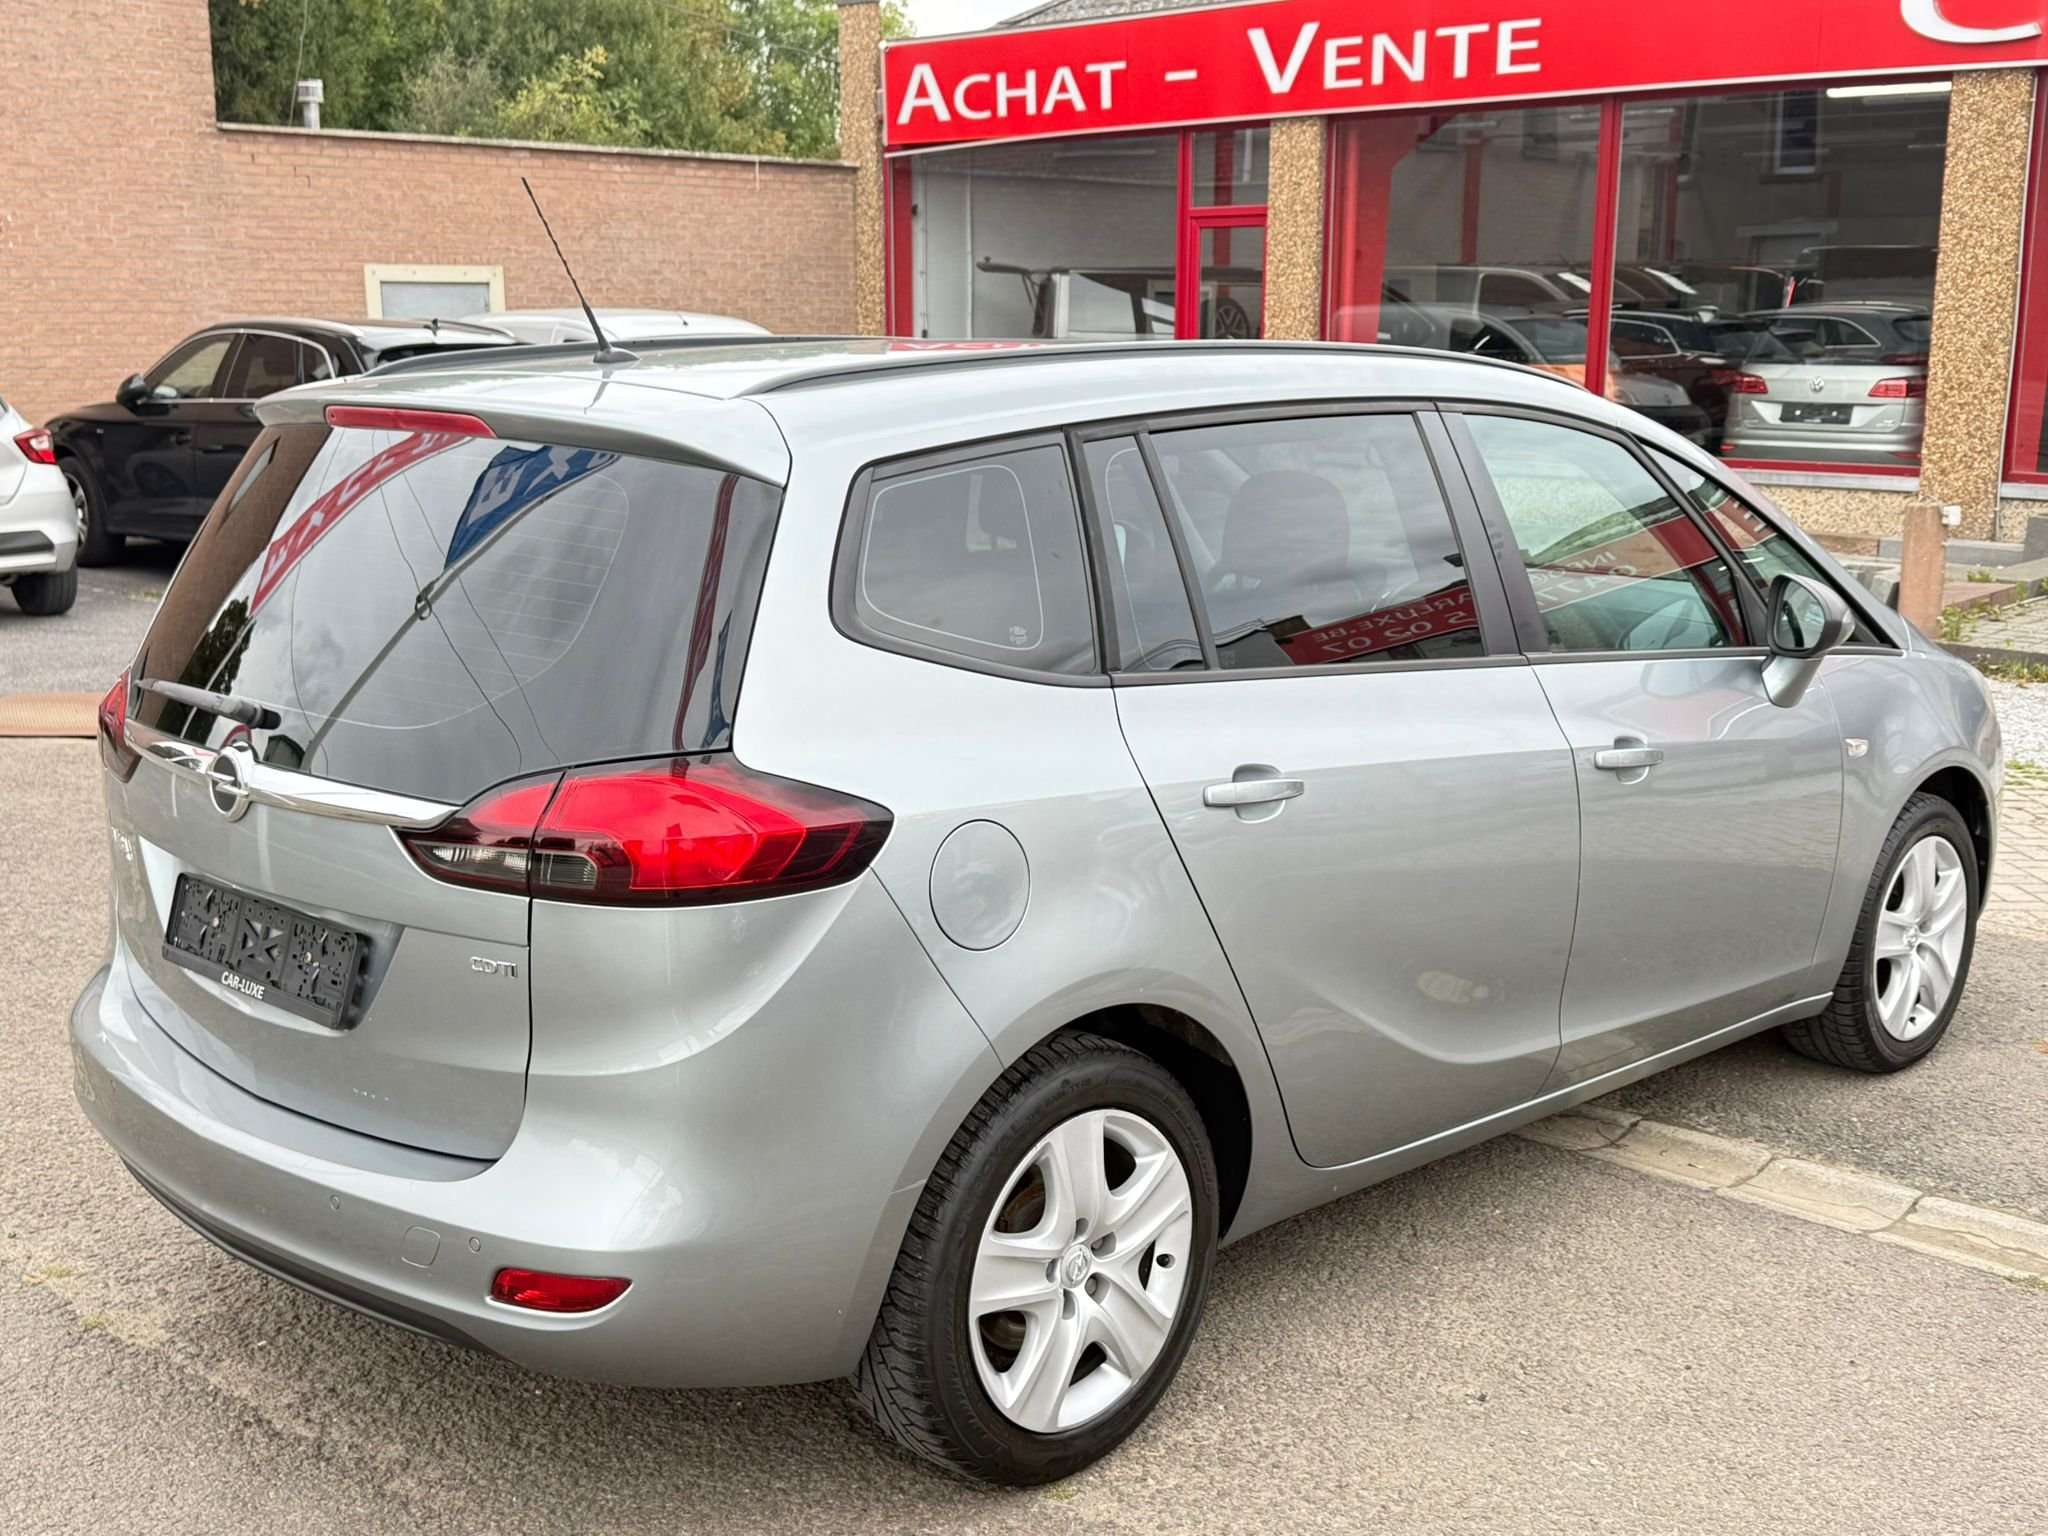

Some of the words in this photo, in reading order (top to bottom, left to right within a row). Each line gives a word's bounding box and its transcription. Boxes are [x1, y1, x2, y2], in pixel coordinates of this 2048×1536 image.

[897, 60, 1127, 126] ACHAT
[1247, 17, 1542, 95] VENTE
[221, 971, 265, 1000] CAR-LUXE
